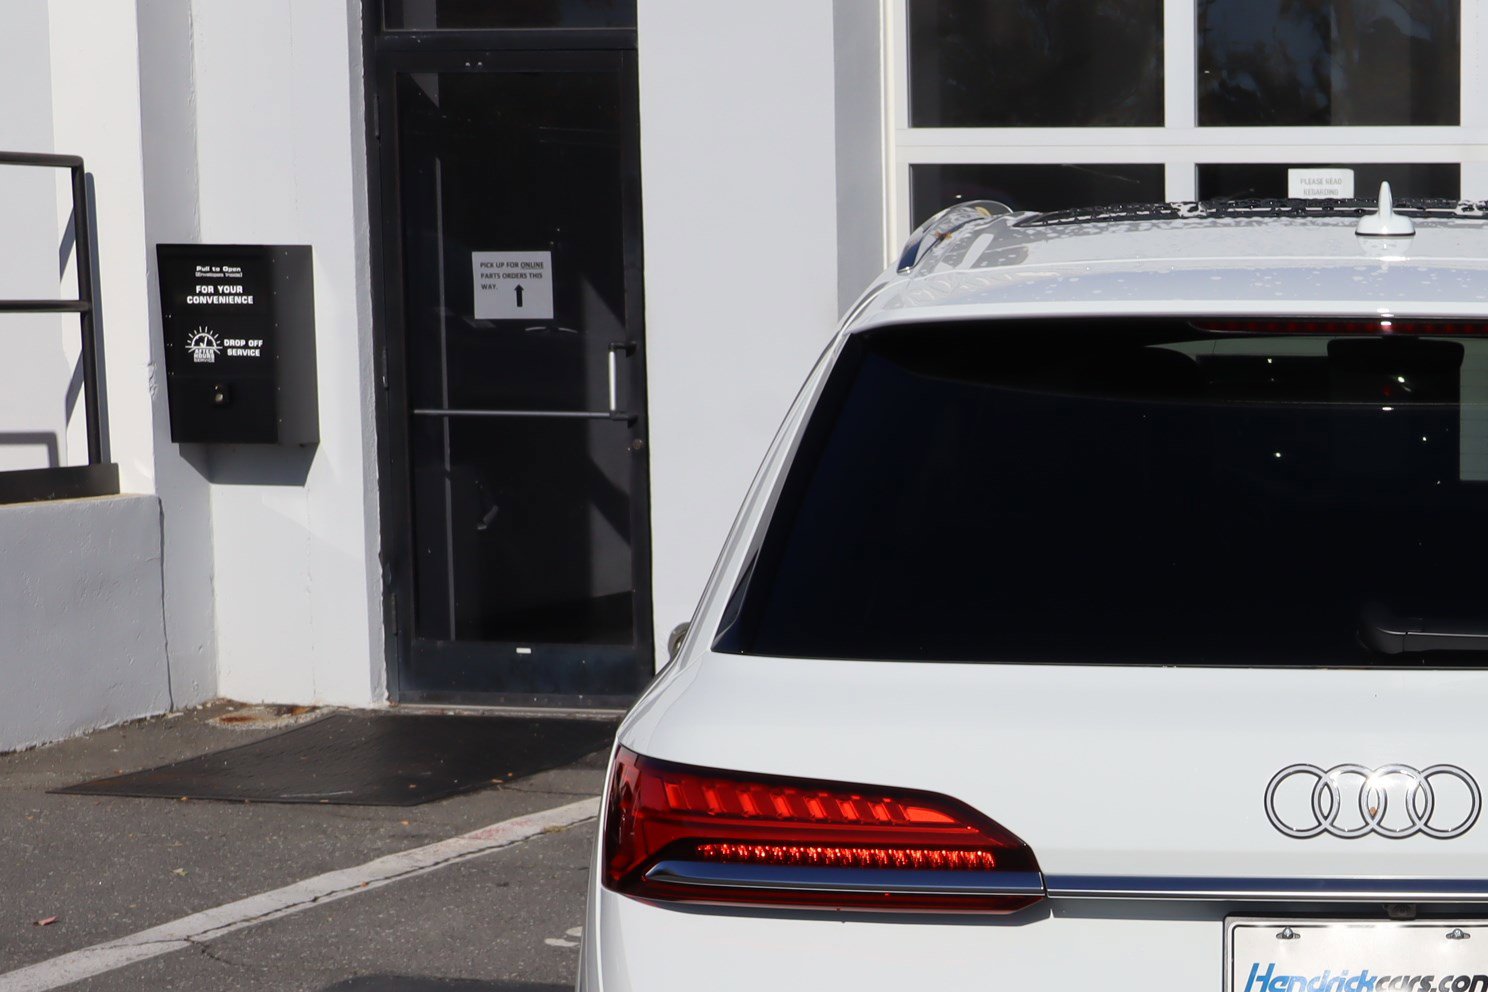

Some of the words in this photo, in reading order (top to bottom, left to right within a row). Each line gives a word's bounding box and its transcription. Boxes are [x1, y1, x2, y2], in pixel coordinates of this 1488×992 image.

[480, 261, 494, 269] PICK
[495, 261, 505, 269] UP
[506, 261, 519, 269] FOR
[520, 261, 544, 270] ONLINE
[480, 272, 501, 280] PARTS
[502, 272, 528, 280] ORDERS
[529, 272, 543, 280] THIS
[195, 285, 215, 294] FOR
[217, 285, 244, 294] YOUR
[186, 295, 254, 305] CONVENIENCE
[223, 338, 246, 347] DROP
[248, 339, 264, 347] OFF
[227, 348, 261, 357] SERVICE
